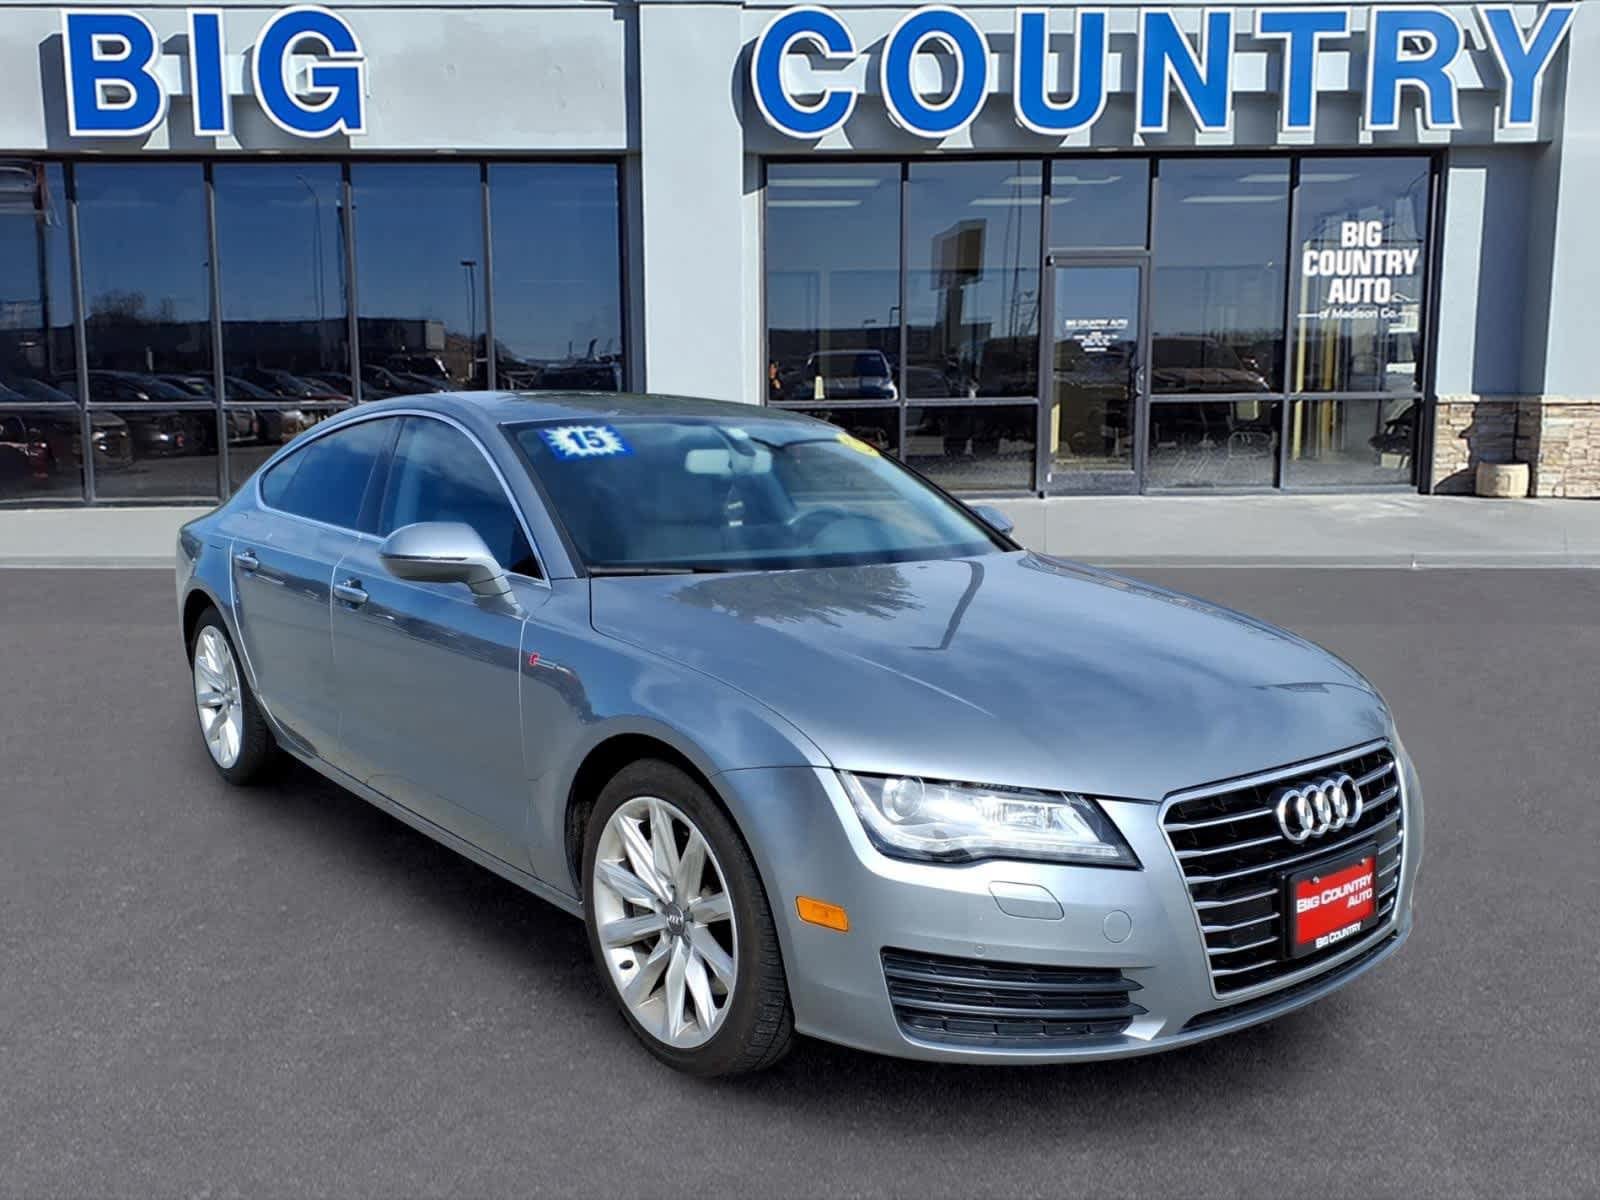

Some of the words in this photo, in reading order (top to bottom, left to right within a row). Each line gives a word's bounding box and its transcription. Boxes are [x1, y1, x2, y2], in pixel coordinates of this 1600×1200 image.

[60, 4, 368, 139] BIG
[750, 4, 1577, 140] COUNTRY
[1341, 220, 1383, 248] BIG
[1302, 248, 1420, 276] COUNTRY
[1327, 277, 1392, 304] AUTO
[1331, 307, 1378, 319] Madison
[567, 430, 606, 450] 15
[1296, 895, 1320, 914] BIG
[1320, 872, 1373, 905] COUNTRY
[1346, 887, 1373, 909] AUTO
[1328, 920, 1361, 944] COUNTRY
